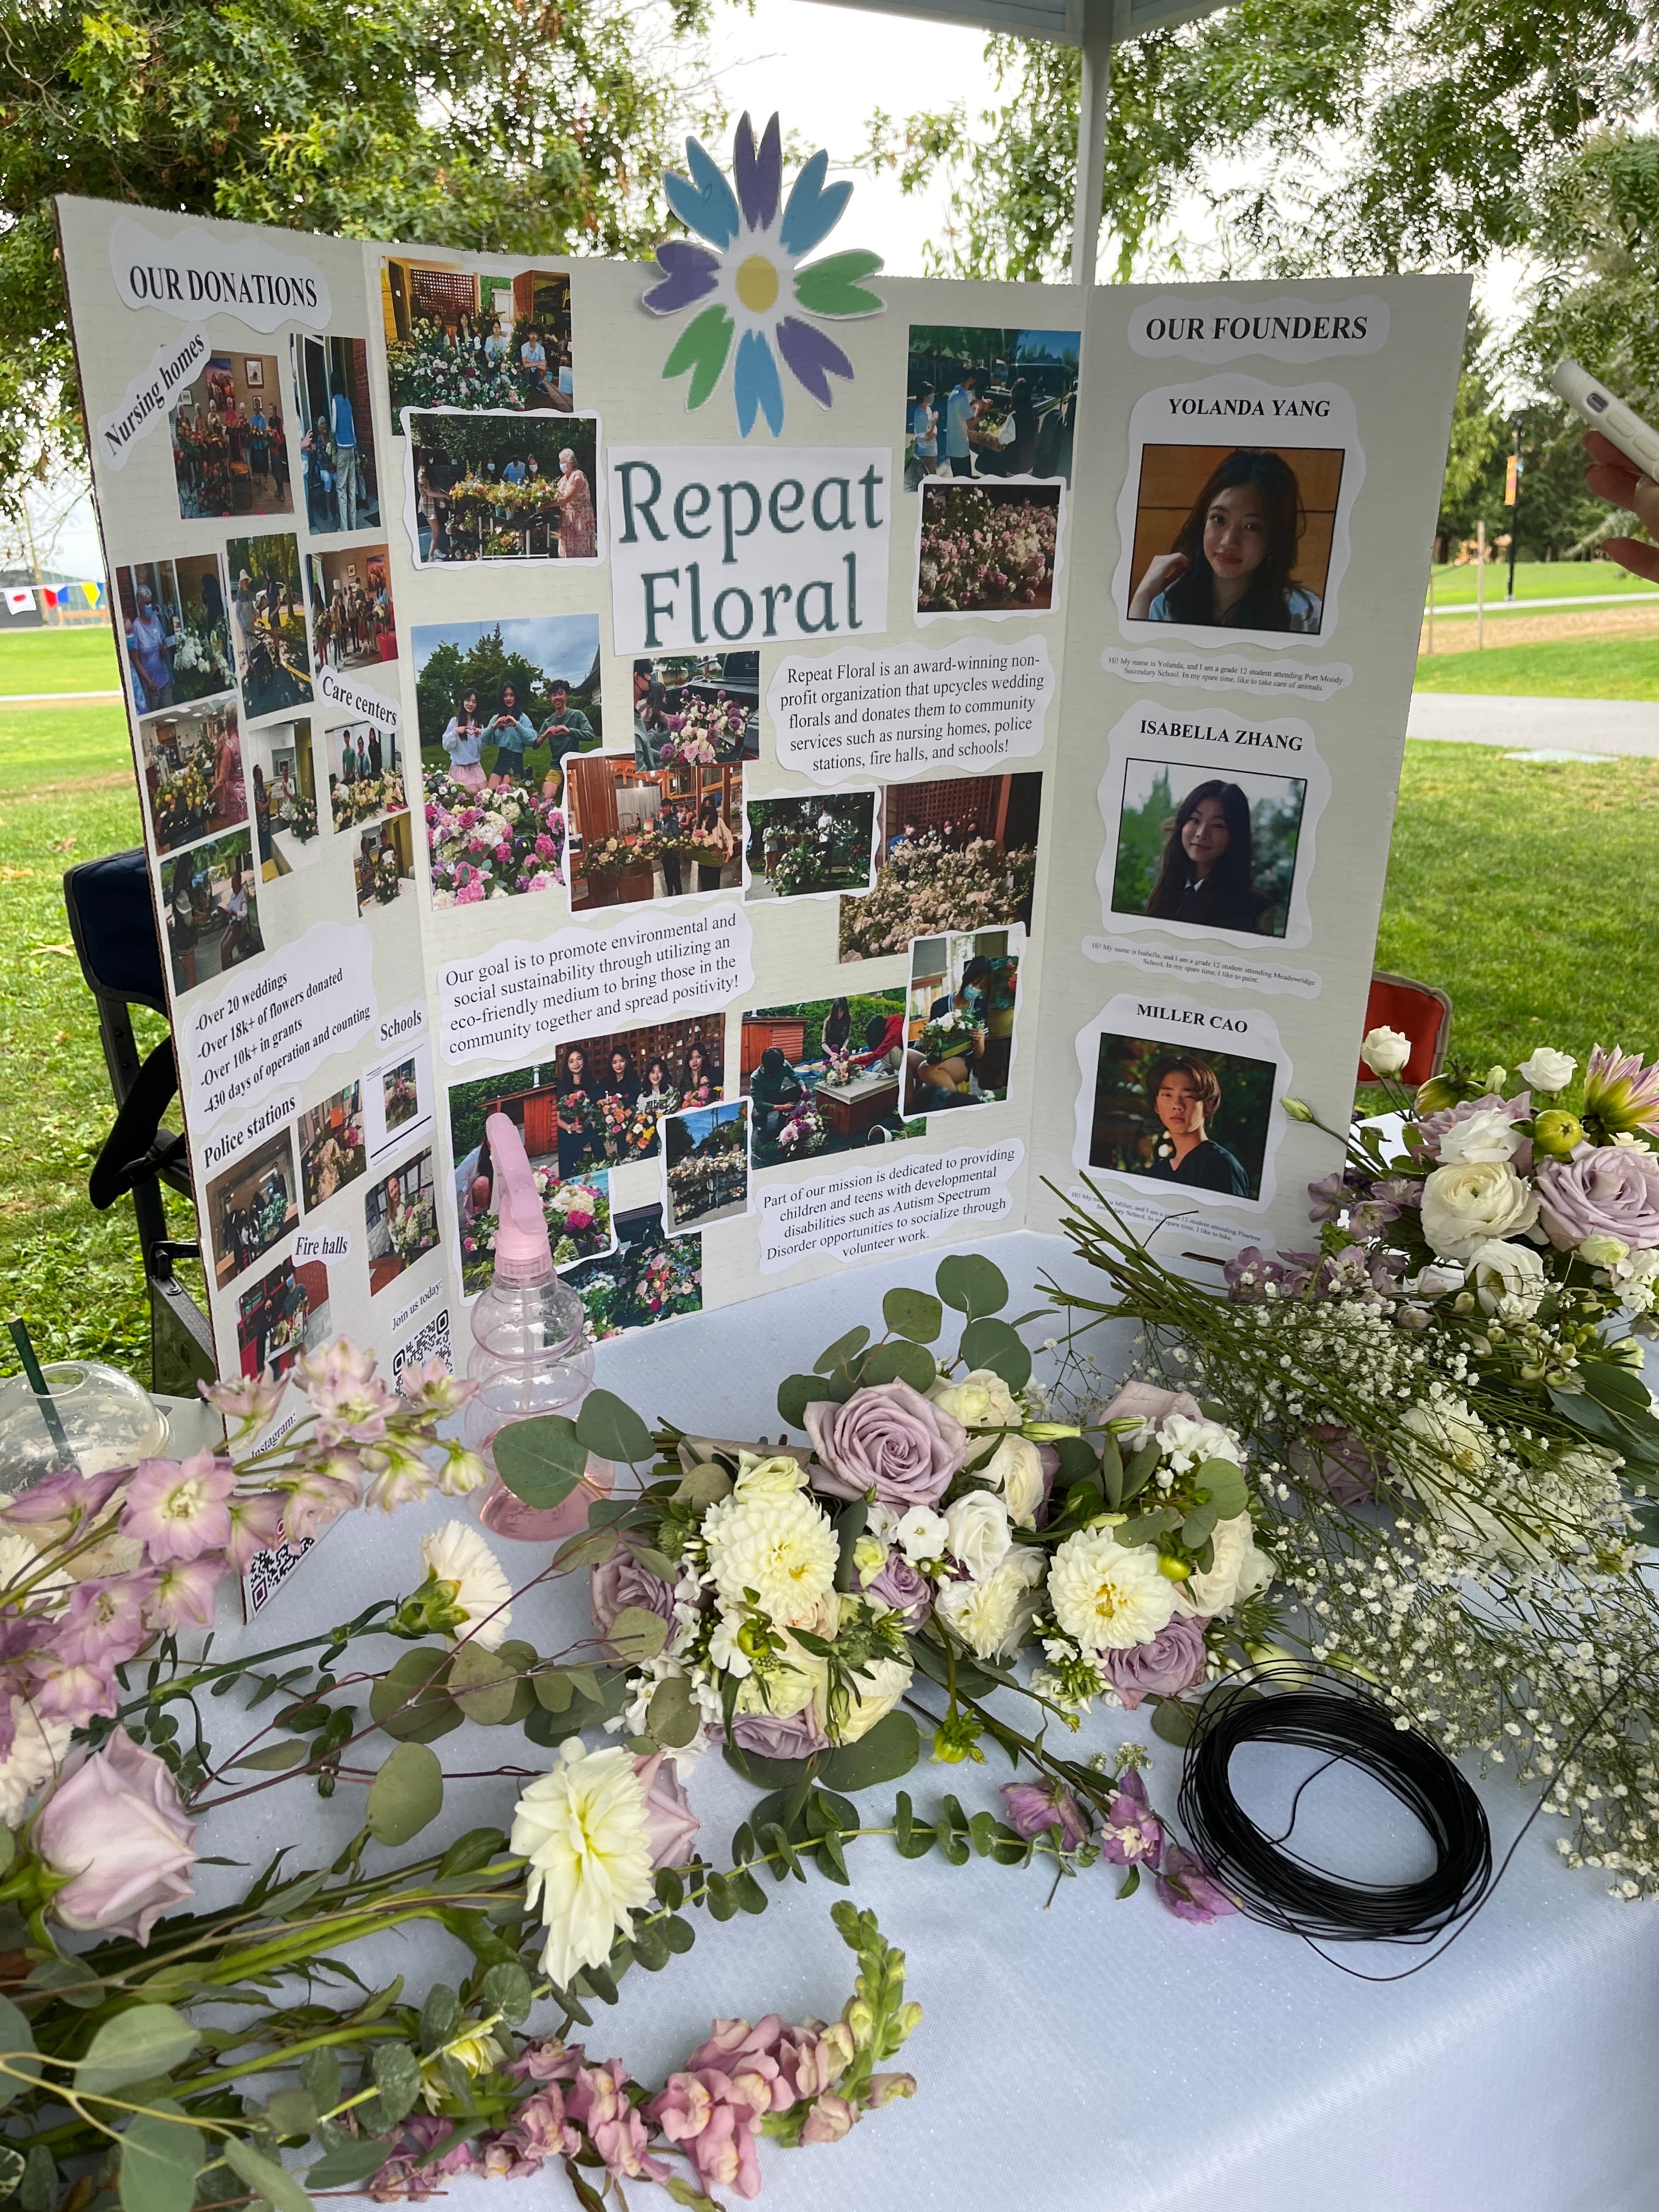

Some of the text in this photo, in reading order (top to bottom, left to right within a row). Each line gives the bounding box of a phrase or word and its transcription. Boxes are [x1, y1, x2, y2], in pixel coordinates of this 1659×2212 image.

[129, 266, 317, 307] OUR DONATIONS
[1146, 317, 1368, 340] OUR FOUNDERS
[104, 332, 205, 456] Nursing homes
[1169, 398, 1330, 417] YOLANDA YANG
[614, 461, 883, 563] Repeat
[641, 551, 862, 648] Floral
[780, 673, 1045, 711] profit organization that upcycles wedding
[787, 654, 1040, 686] Repeat Floral is an award-winning non-
[1120, 658, 1131, 666] My
[1158, 661, 1185, 670] Yolanda,
[1273, 672, 1303, 681] attending
[1320, 675, 1344, 685] Moody
[323, 676, 397, 726] Care centers
[789, 695, 1036, 729] florals and donates them to community
[791, 716, 1032, 751] services such as nursing homes, police
[813, 739, 1008, 771] stations, fire halls, and schools!
[1139, 720, 1303, 751] ISABELLA ZHANG
[446, 912, 736, 986] Our goal is to promote environmental and
[454, 939, 730, 1007] social sustainability through utilizing an
[195, 973, 287, 1030] -Over 20 weddings
[450, 956, 736, 1031] eco-friendly medium to bring those in the
[1273, 972, 1316, 986] Meadowridge
[198, 967, 343, 1058] -Over 18k+ of flowers donated
[381, 1009, 421, 1041] Schools
[449, 974, 738, 1053] community together and spread positivity!
[1136, 1003, 1248, 1033] MILLER CAO
[200, 1019, 302, 1086] -Over 10k+ in grants
[204, 1007, 370, 1113] -430 days of operation and counting
[204, 1097, 295, 1169] Police stations
[764, 1149, 1015, 1209] Part of our mission is dedicated to providing
[780, 1166, 996, 1221] children and teens with developmental
[766, 1198, 1006, 1260] Disorder opportunities to socialize through
[784, 1187, 990, 1238] disabilities such as Autism Spectrum
[295, 1236, 348, 1255] Fire halls
[842, 1228, 929, 1257] volunteer work.
[393, 1280, 442, 1330] Join us today:
[252, 1413, 296, 1458] Instagram:
